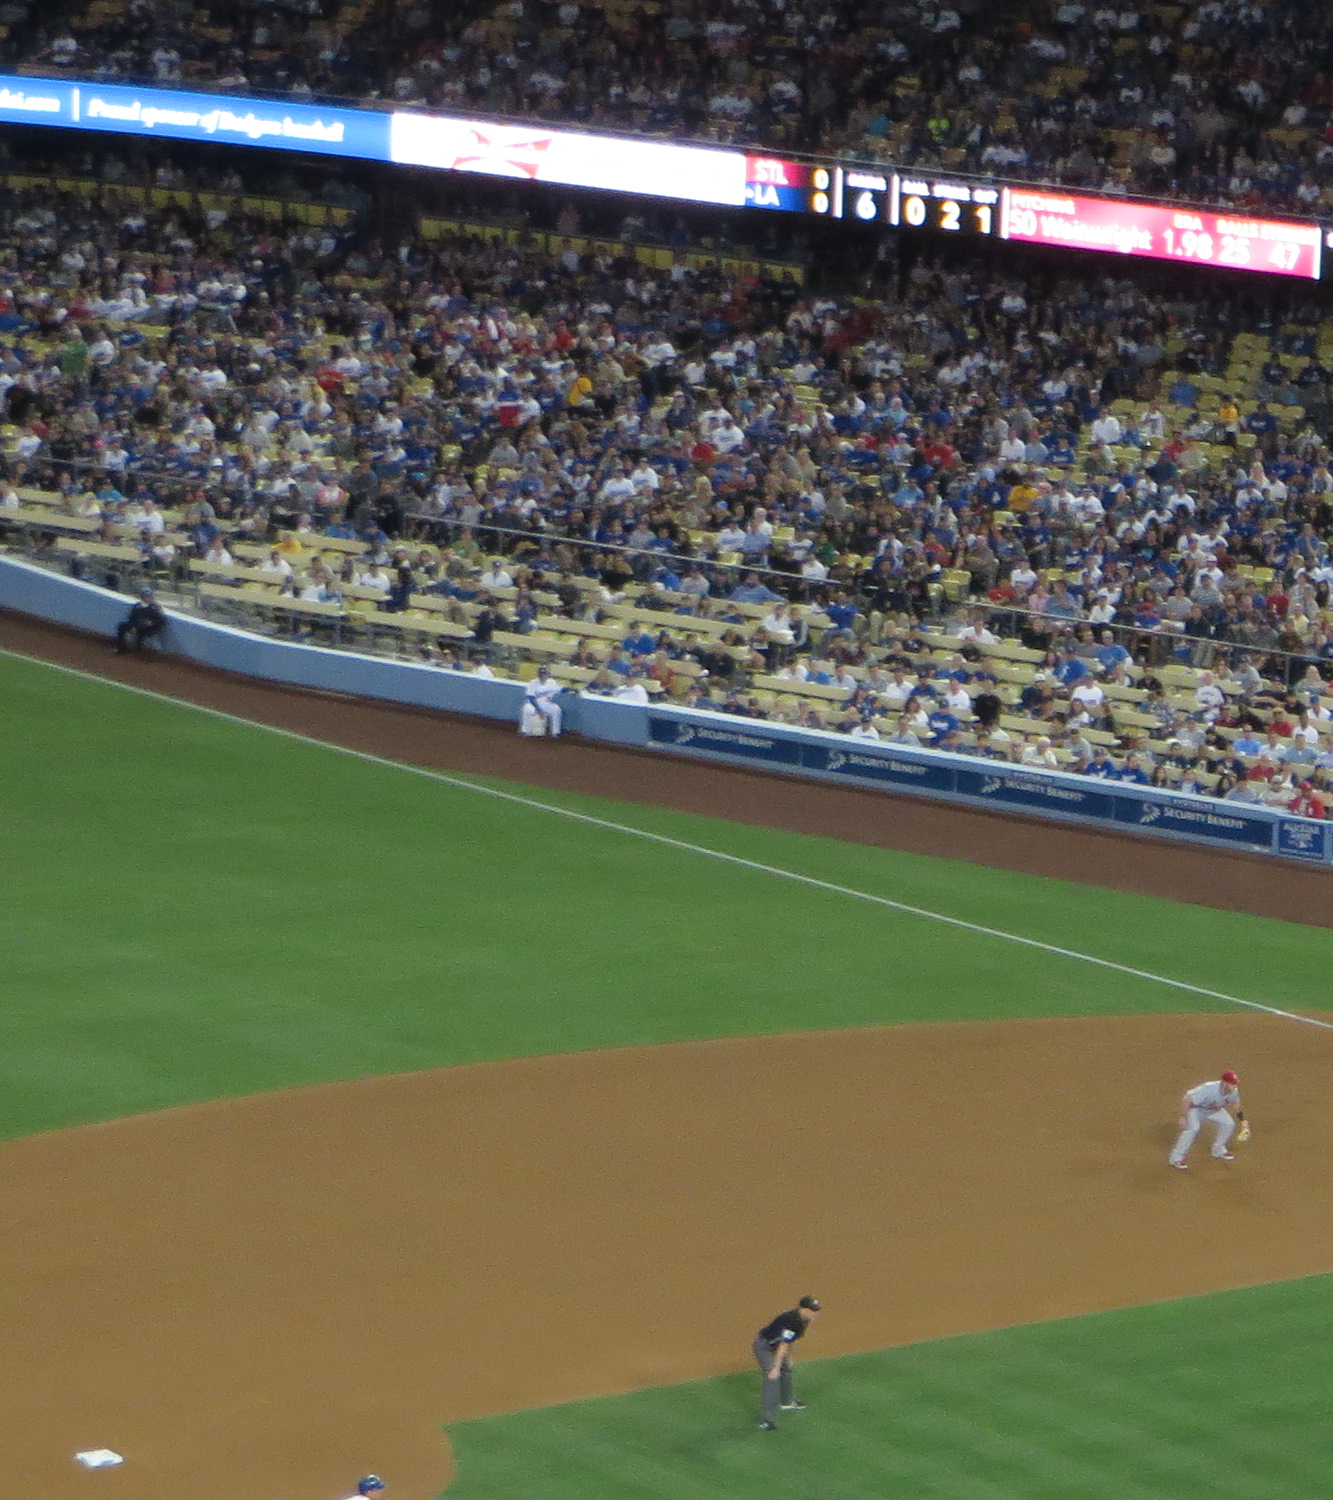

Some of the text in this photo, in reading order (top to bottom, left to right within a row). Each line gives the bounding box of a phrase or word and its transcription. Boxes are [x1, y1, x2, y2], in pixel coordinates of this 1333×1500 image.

[755, 159, 829, 190] STL 0
[755, 183, 829, 213] LA 0
[857, 191, 876, 220] 6
[905, 196, 991, 235] 0 2 1
[1009, 208, 1037, 235] 50
[1163, 228, 1213, 261] 1.98
[1219, 235, 1250, 265] 25
[1268, 240, 1301, 271] 47
[1164, 806, 1245, 829] SECURITY BENEFIT
